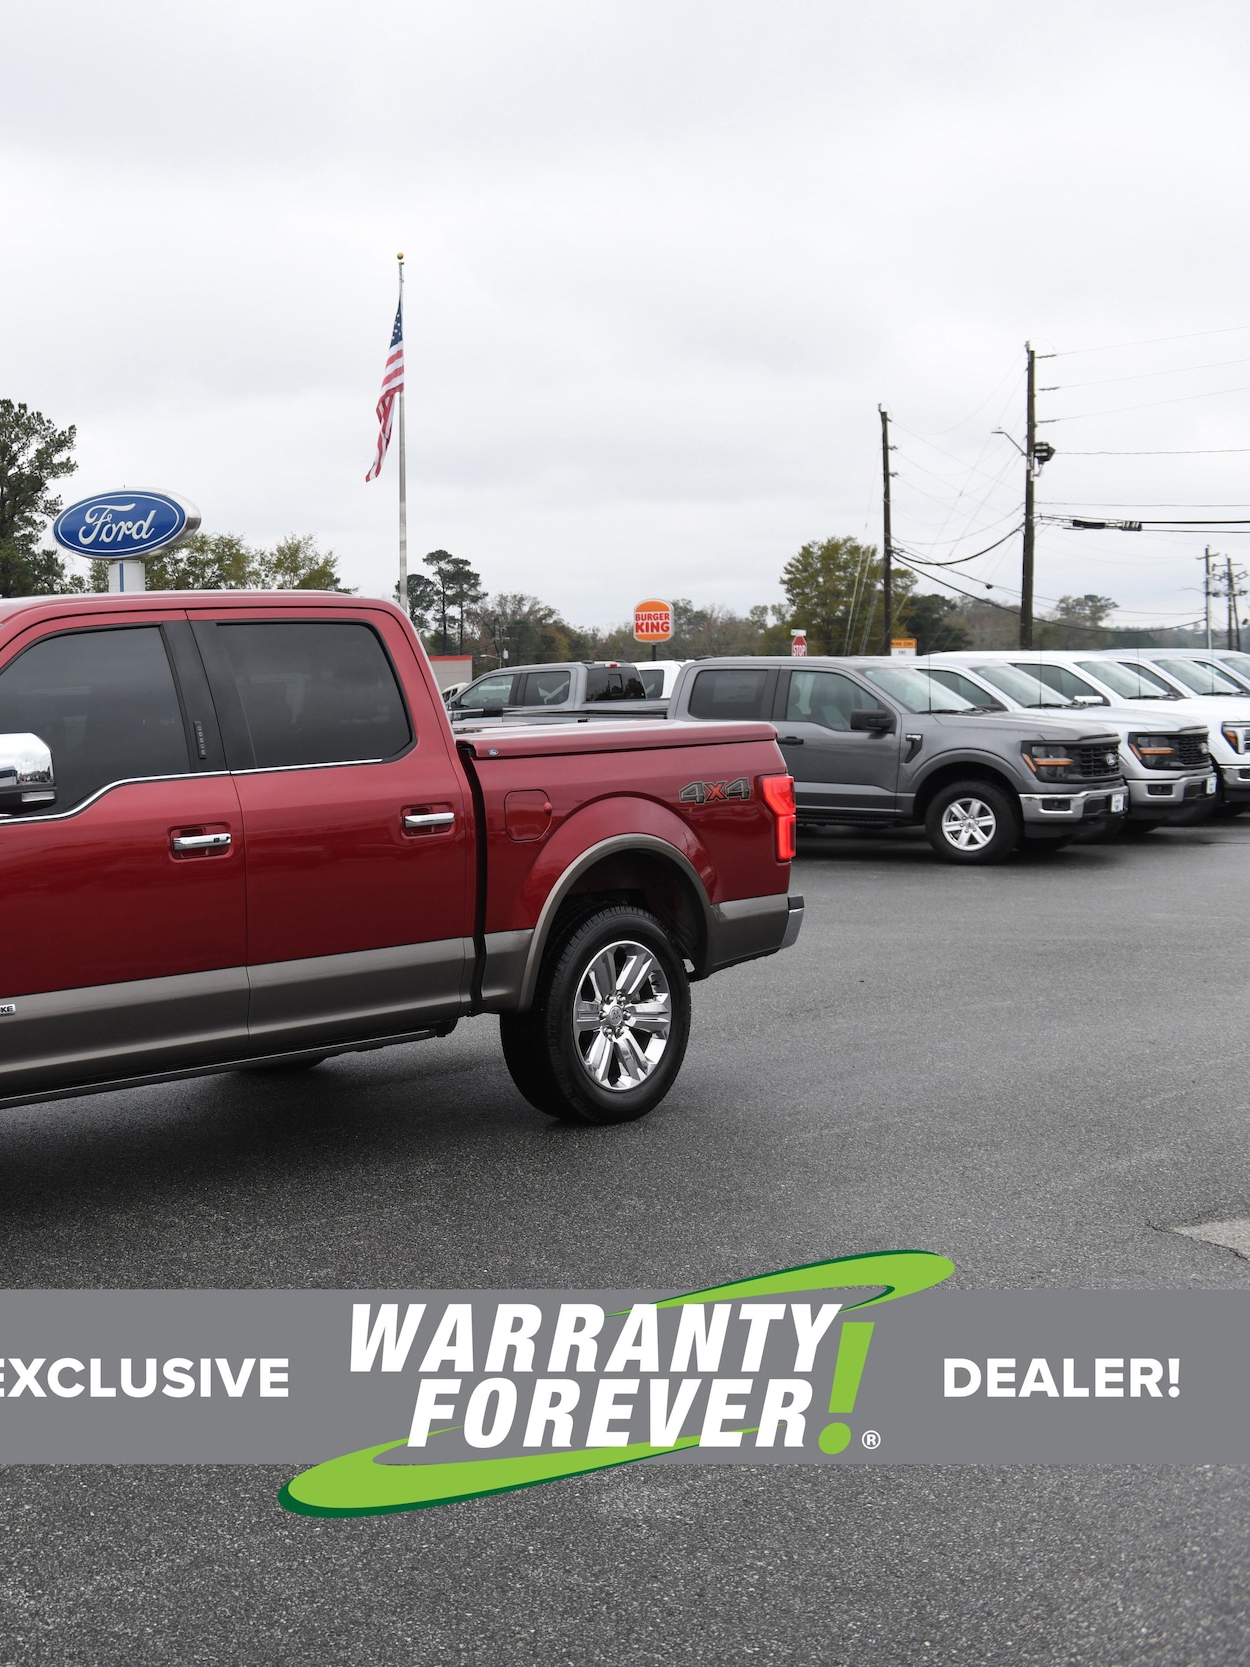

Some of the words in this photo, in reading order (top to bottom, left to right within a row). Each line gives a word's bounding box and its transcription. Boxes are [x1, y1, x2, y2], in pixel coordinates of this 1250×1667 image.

[78, 503, 157, 545] Ford
[635, 613, 670, 621] BURGER
[635, 621, 670, 633] KING
[792, 644, 807, 656] STOP
